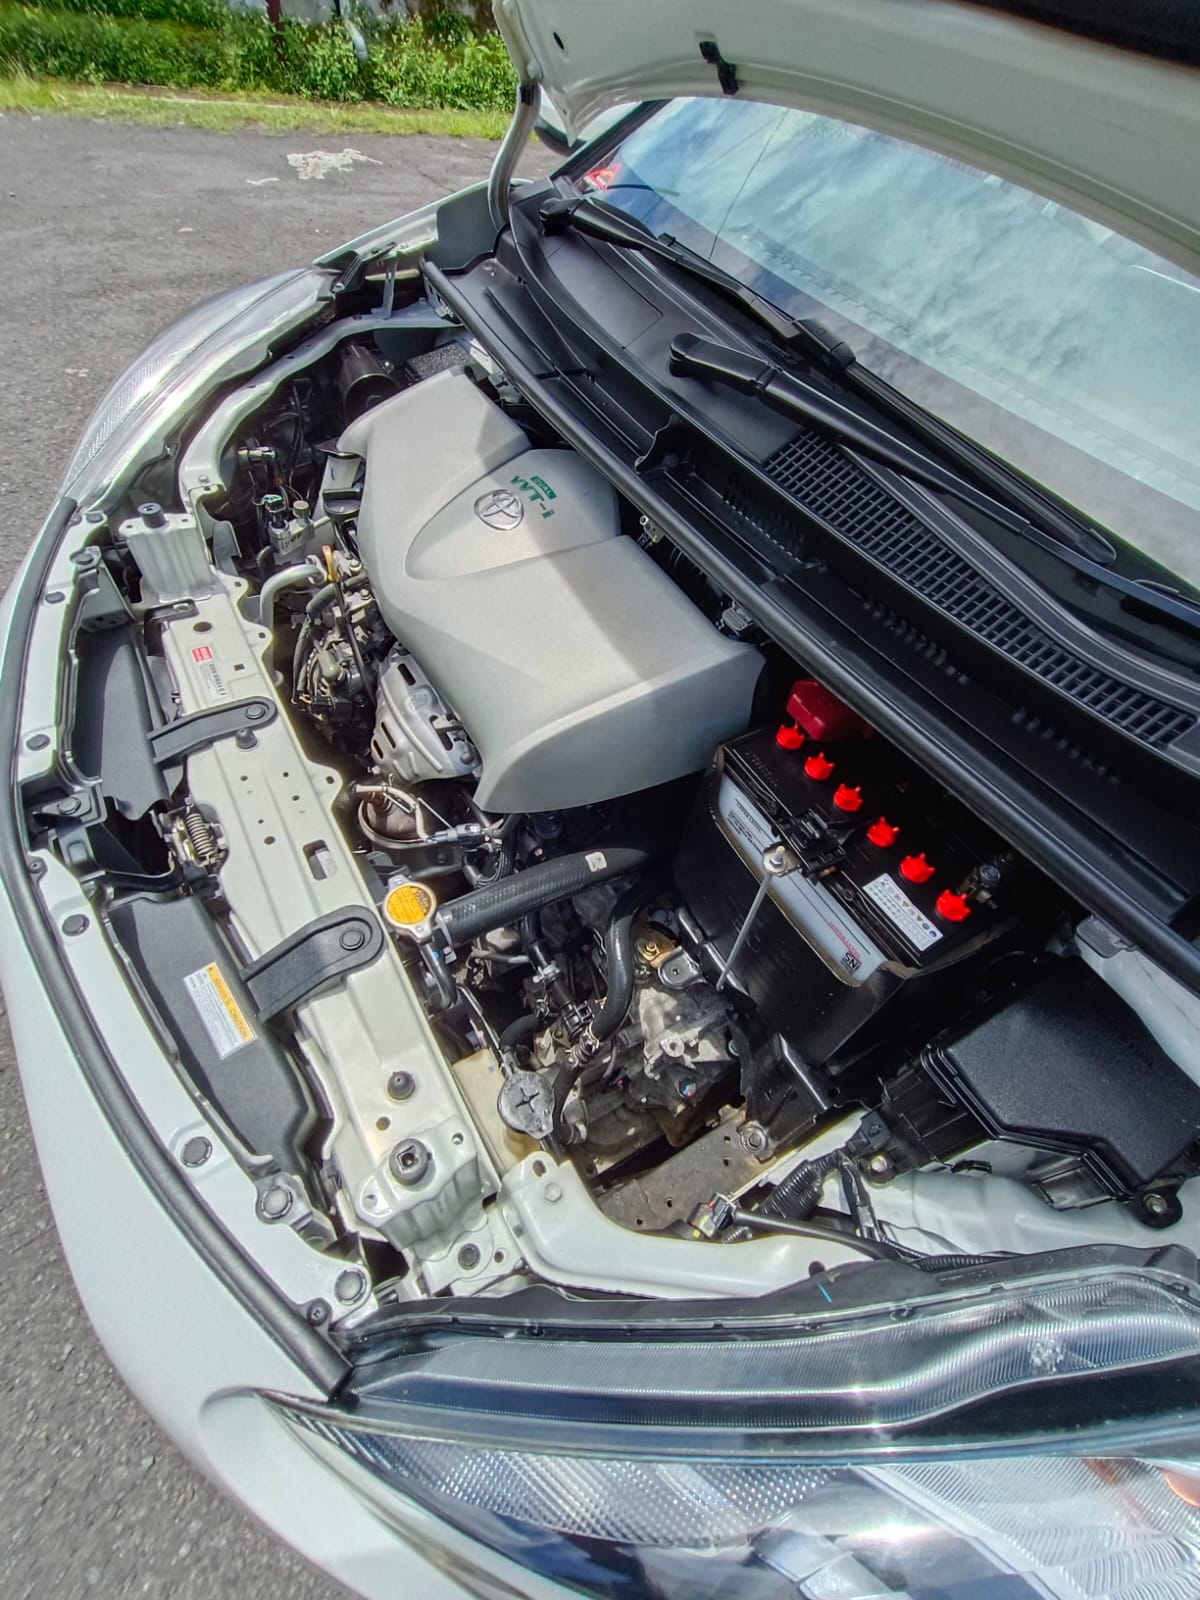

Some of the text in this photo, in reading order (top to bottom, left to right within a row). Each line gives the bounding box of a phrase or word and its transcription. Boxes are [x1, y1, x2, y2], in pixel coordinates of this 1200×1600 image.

[511, 476, 554, 518] VVT-i
[533, 477, 553, 497] DUAL
[845, 952, 861, 972] SNI
[229, 1007, 249, 1039] CAUTION
